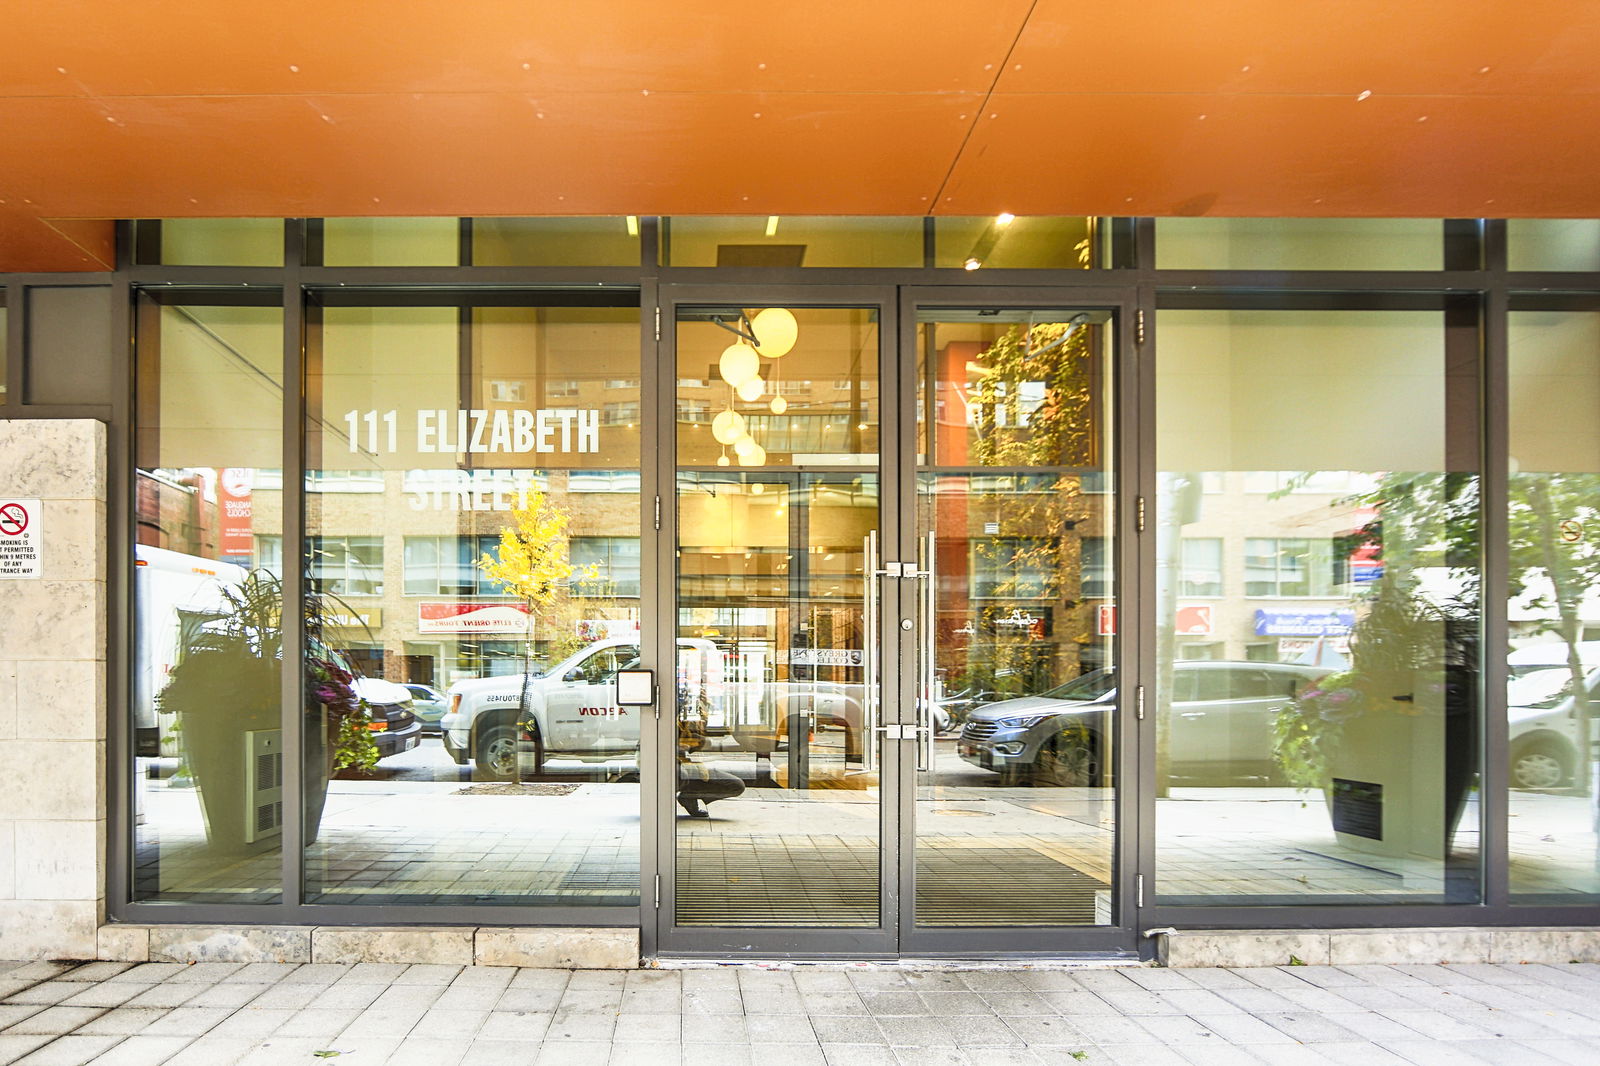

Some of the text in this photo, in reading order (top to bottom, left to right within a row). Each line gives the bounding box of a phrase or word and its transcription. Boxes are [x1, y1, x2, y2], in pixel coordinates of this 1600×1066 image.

[344, 409, 600, 453] 111 ELIZABETH
[408, 468, 535, 511] STREET
